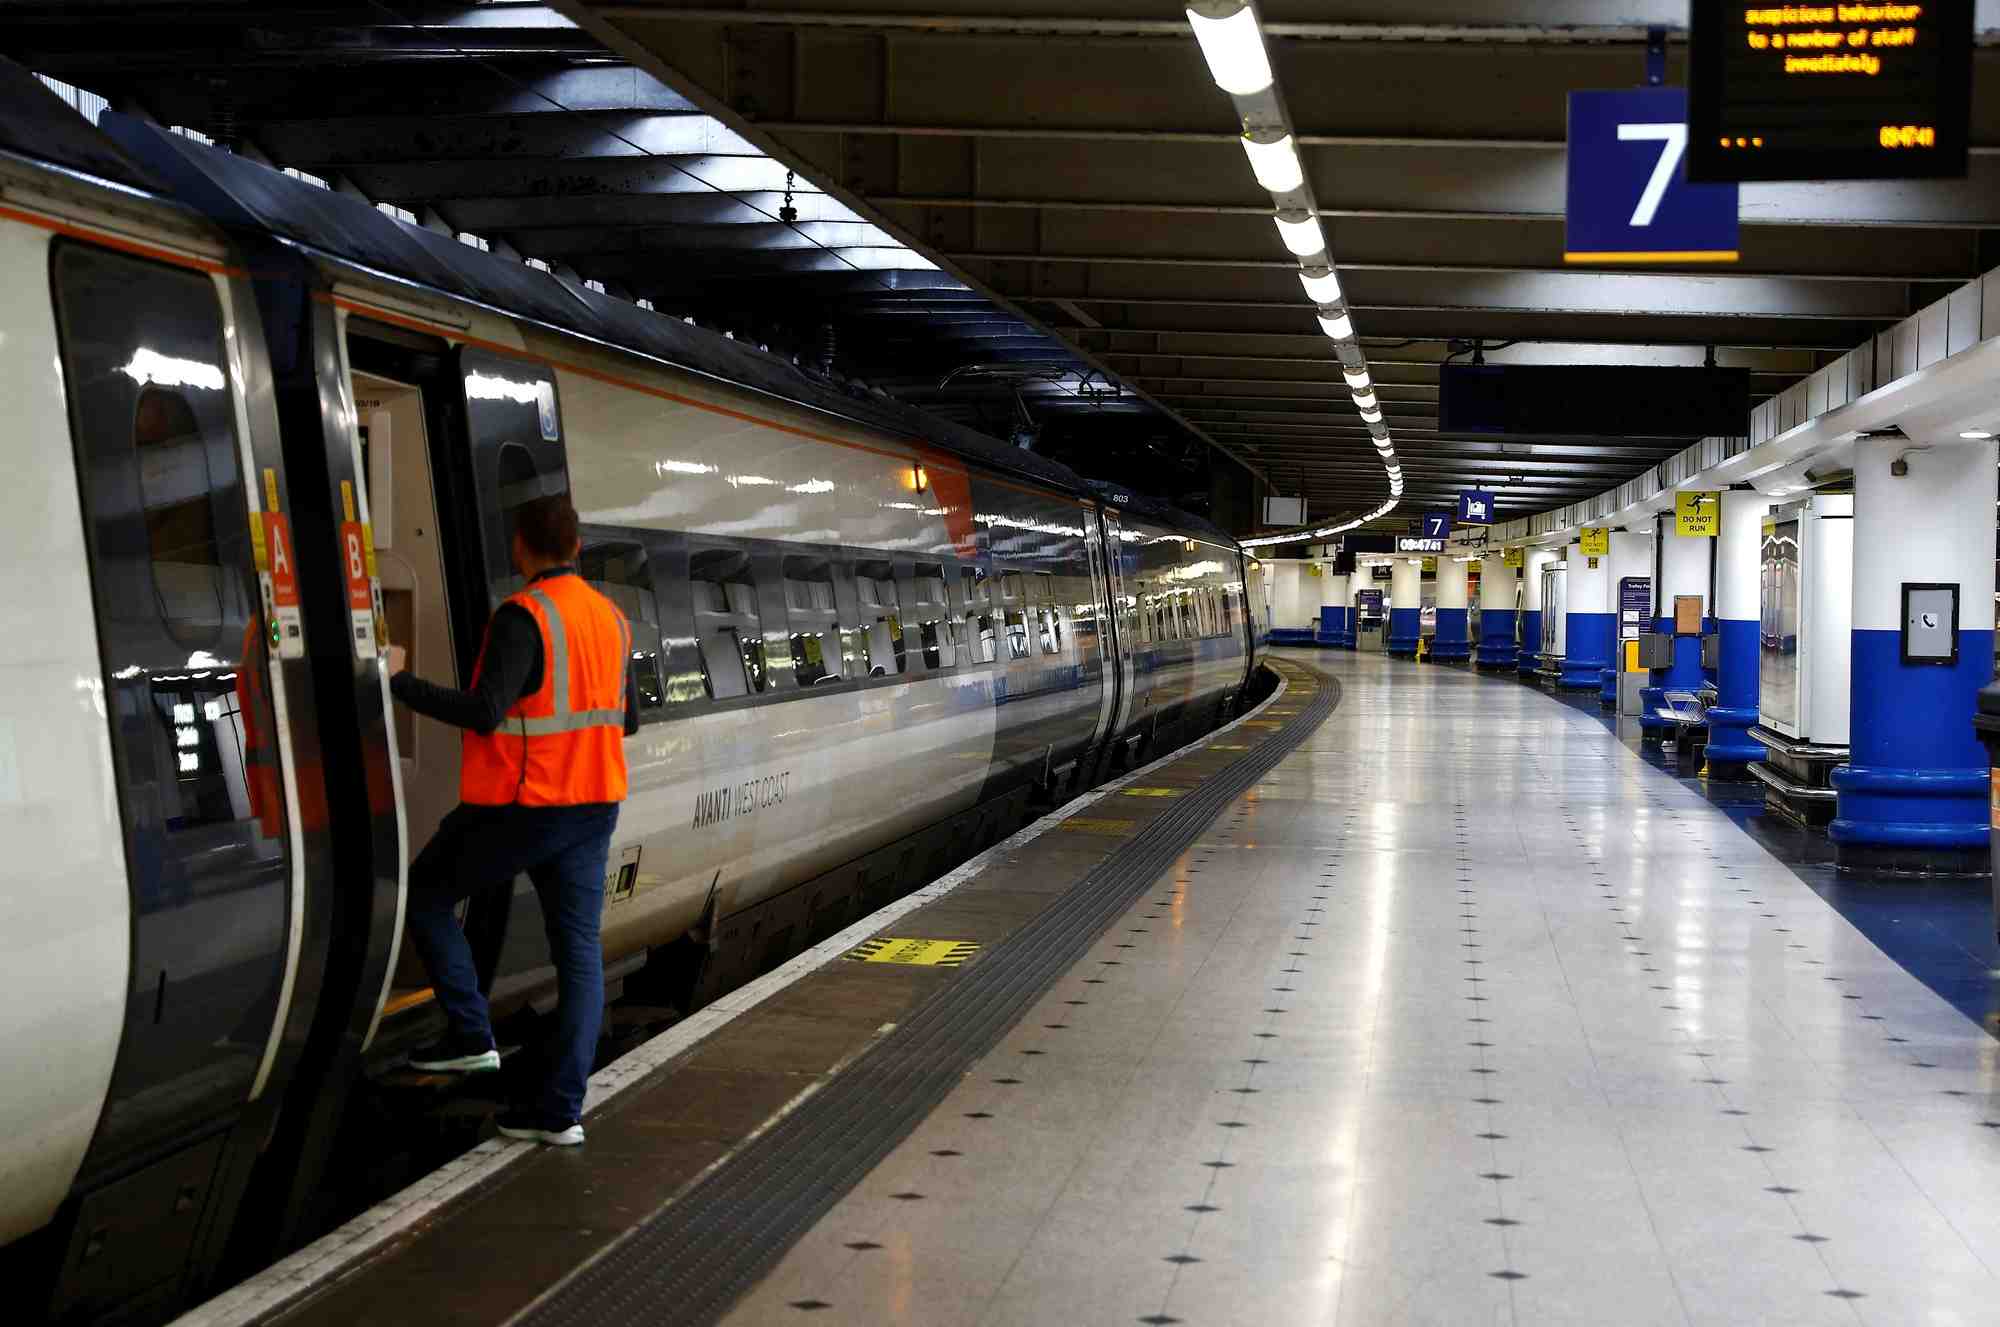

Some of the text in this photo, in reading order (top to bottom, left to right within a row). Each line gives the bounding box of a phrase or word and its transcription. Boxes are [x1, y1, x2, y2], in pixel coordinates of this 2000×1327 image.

[1745, 3, 1921, 26] suspicious behaviour
[1748, 30, 1769, 48] to
[1771, 33, 1785, 48] a
[1848, 28, 1868, 47] of
[1871, 26, 1918, 47] staff
[1617, 123, 1688, 226] 7
[1112, 494, 1129, 503] 803
[1430, 519, 1443, 535] 7
[273, 524, 290, 575] A
[347, 533, 363, 579] B
[692, 771, 790, 830] AVANTI WEST COAST
